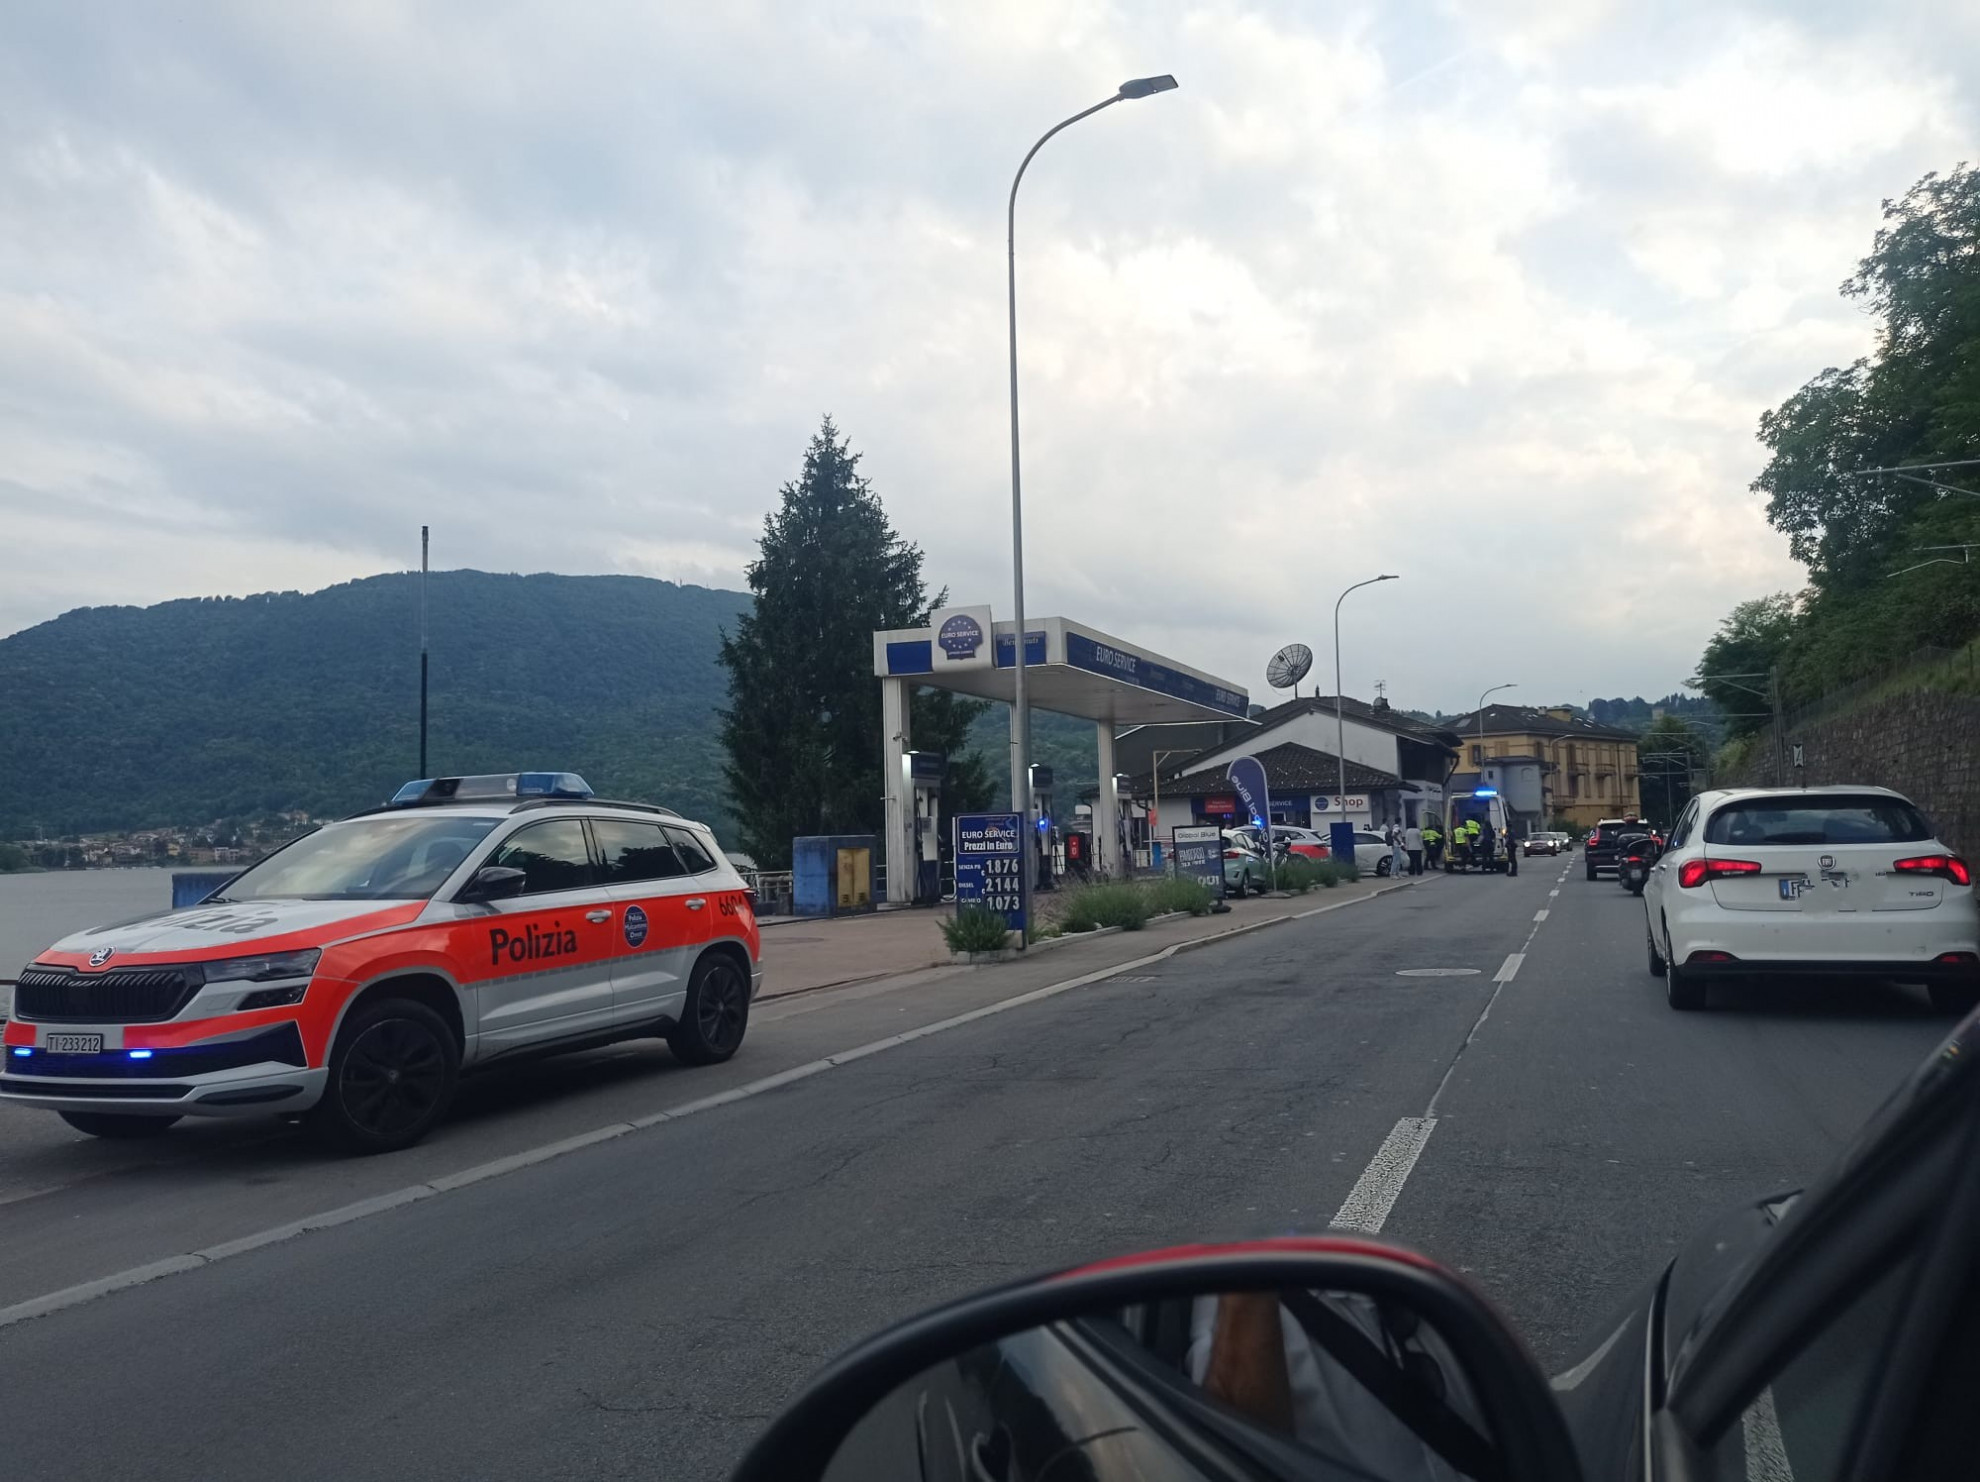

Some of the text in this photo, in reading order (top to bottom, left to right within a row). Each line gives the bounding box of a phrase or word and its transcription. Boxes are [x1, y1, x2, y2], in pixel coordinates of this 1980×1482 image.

[957, 630, 979, 638] SERVICE
[1096, 646, 1136, 673] EURO SERVICE
[961, 829, 1015, 839] EURO SERVICE
[964, 841, 986, 850] Prezzi
[995, 840, 1013, 850] Euro
[488, 920, 578, 966] Polizia
